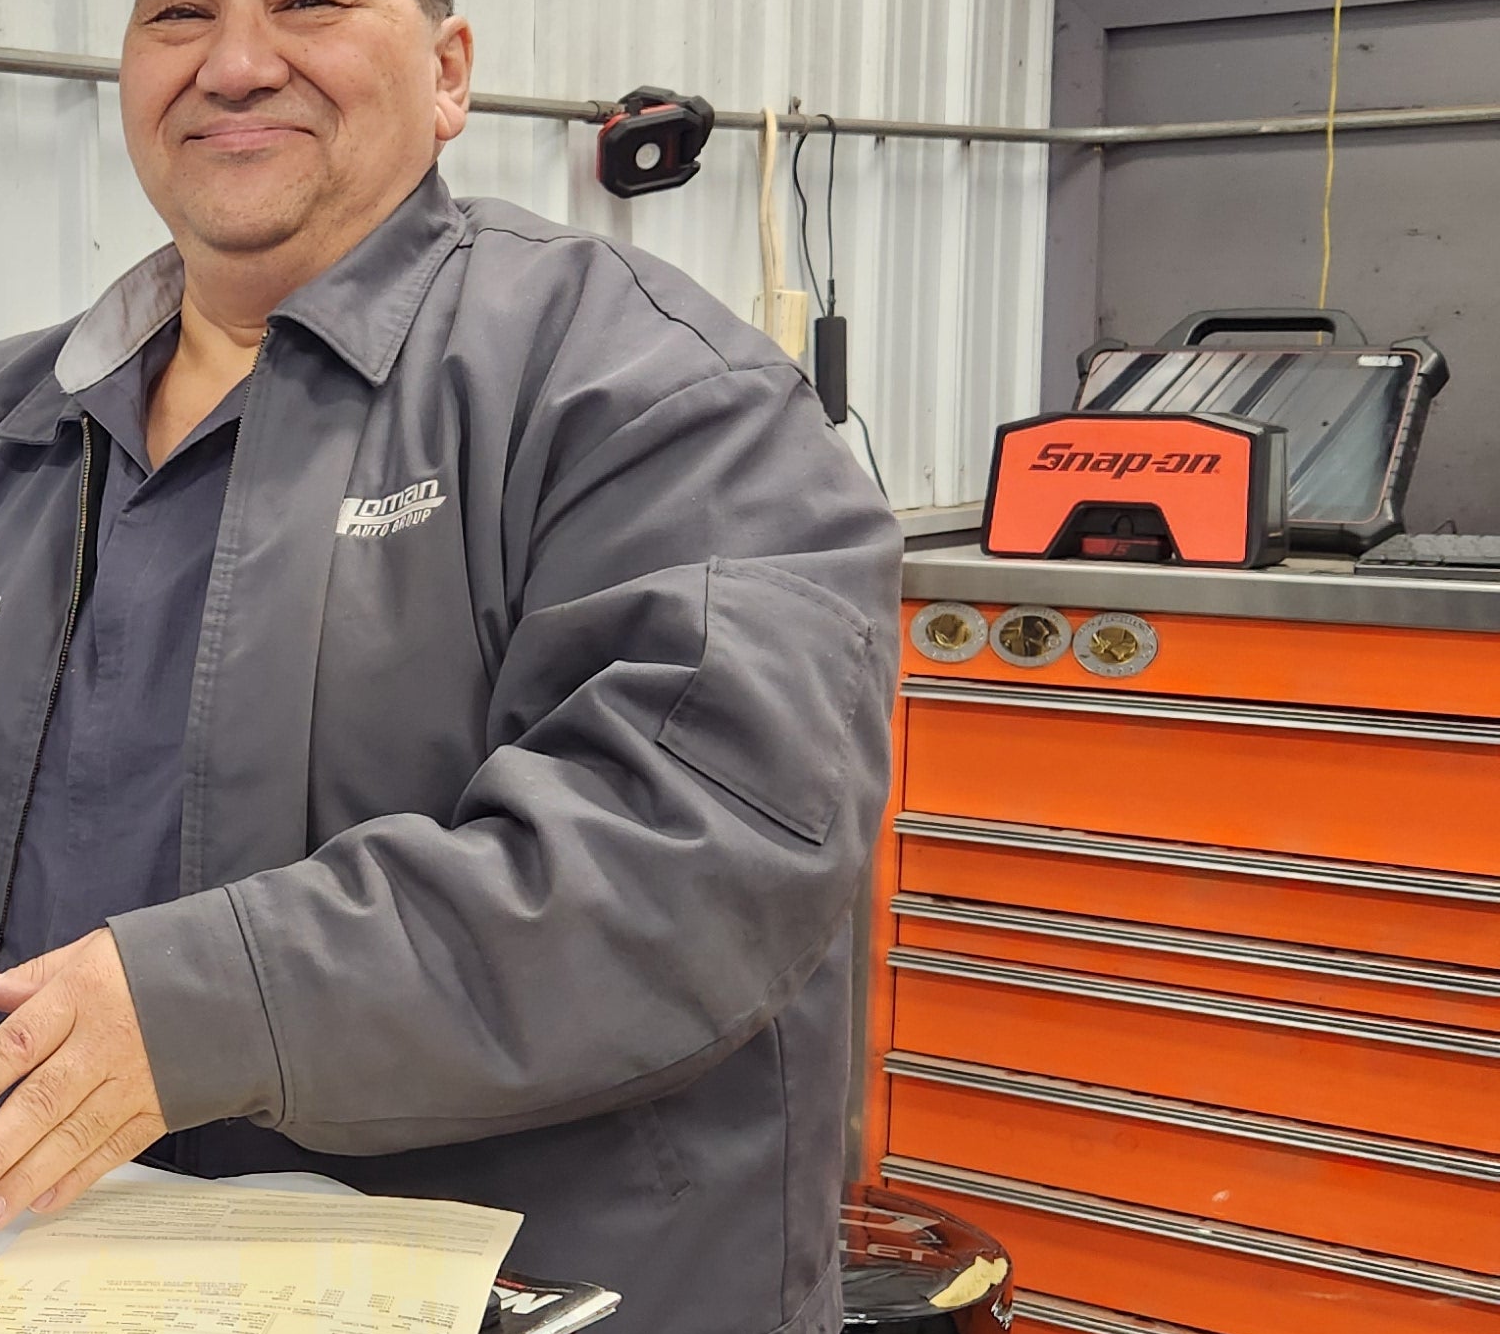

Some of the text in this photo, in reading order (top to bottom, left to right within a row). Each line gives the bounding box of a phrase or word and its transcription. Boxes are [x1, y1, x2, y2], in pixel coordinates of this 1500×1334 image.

[1028, 443, 1221, 479] Snap-on
[350, 509, 432, 538] AUTO GROUP
